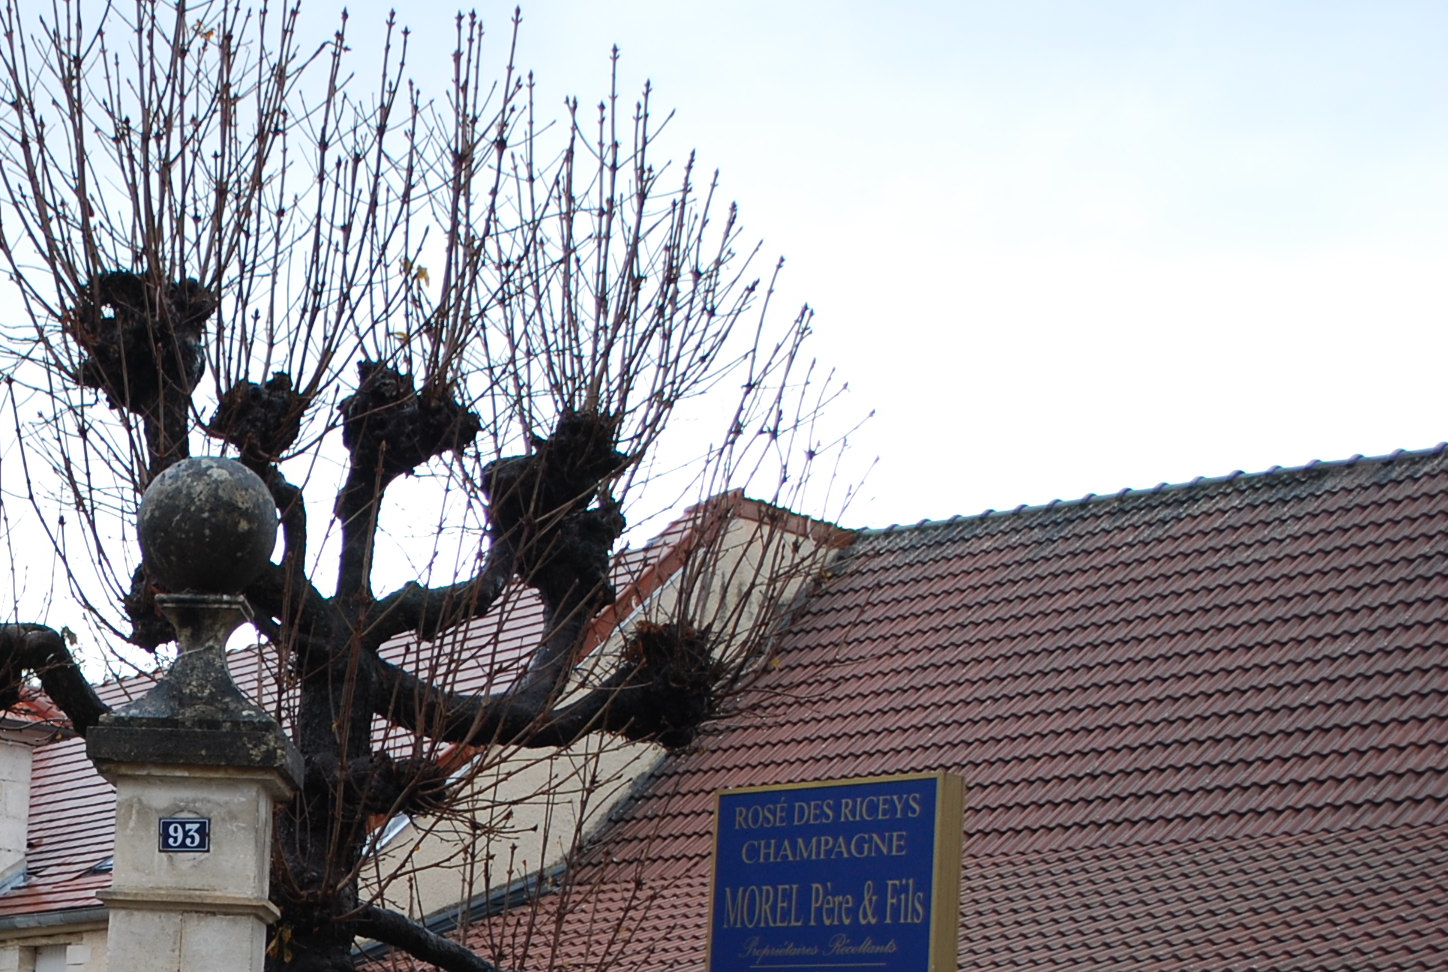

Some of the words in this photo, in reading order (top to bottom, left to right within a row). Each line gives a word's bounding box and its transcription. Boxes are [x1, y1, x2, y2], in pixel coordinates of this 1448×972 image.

[734, 797, 787, 830] ROSÉ
[793, 800, 834, 826] DES
[840, 793, 921, 822] RICEYS
[168, 823, 200, 847] 93
[741, 831, 907, 864] CHAMPAGNE
[722, 883, 803, 929] MOREL
[808, 882, 853, 926] Père
[858, 880, 878, 925] &
[885, 878, 925, 924] Fils
